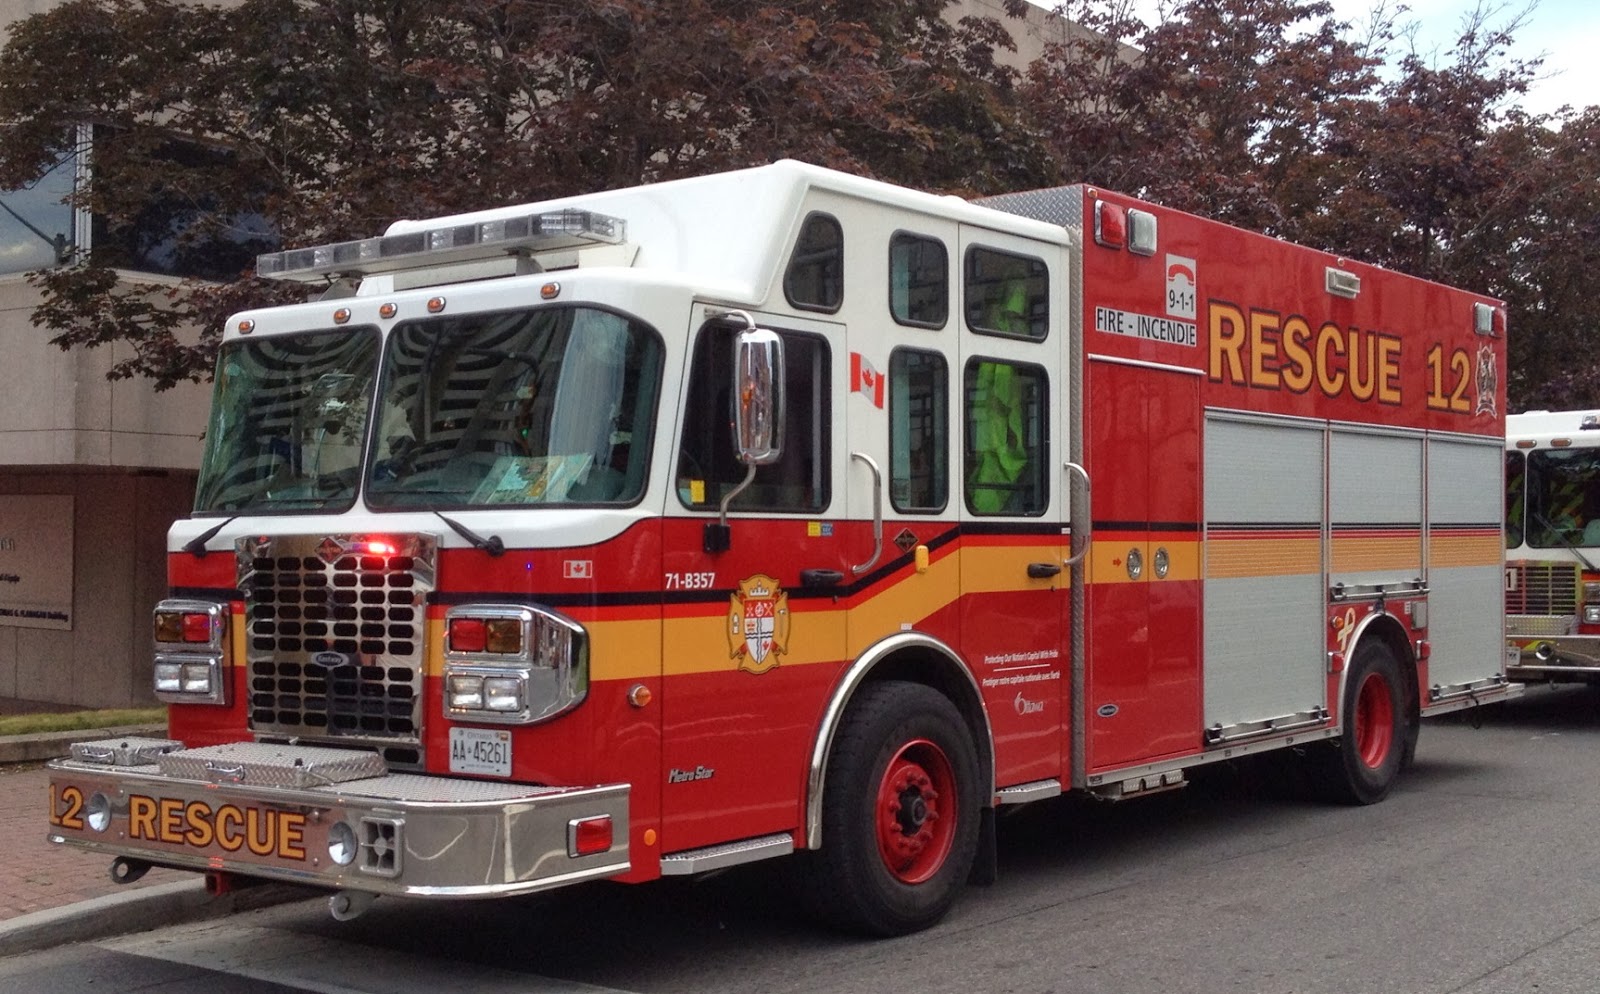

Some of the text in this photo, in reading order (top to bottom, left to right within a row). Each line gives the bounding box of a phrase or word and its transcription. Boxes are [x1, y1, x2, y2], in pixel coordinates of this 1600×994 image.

[1169, 289, 1194, 312] 9-1-1
[1097, 308, 1124, 333] FIRE
[1137, 315, 1196, 345] INCENDIE
[1208, 299, 1471, 415] RESCUE 12
[984, 654, 1004, 665] Protecting
[695, 765, 715, 780] Star
[129, 794, 306, 861] RESCUE
